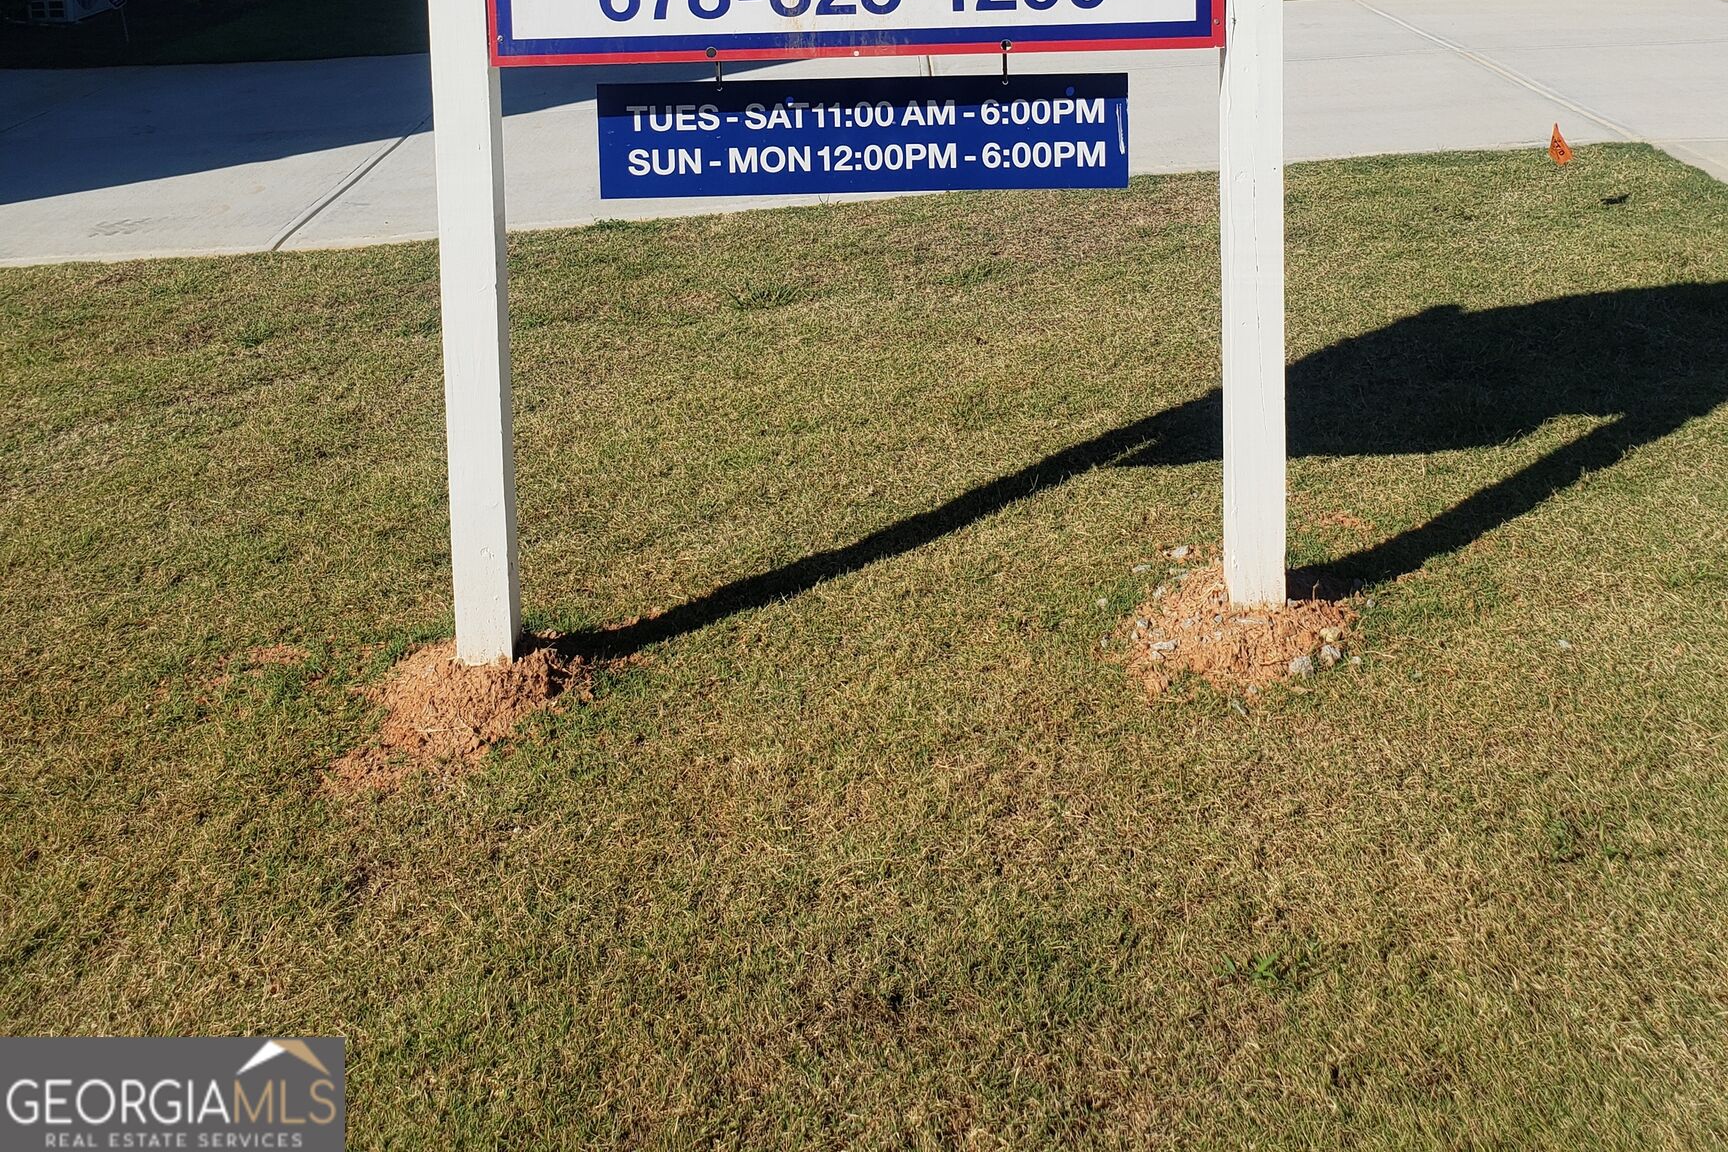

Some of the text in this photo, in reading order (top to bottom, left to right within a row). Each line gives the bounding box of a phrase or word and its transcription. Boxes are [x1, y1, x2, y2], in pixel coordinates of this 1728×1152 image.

[626, 104, 721, 133] TUES
[744, 101, 808, 130] SAT
[811, 101, 896, 129] 11:00
[901, 99, 956, 127] AM
[980, 97, 1106, 127] 6:00PM
[627, 147, 703, 176] SUN
[728, 145, 812, 174] MON
[817, 142, 957, 172] 12:00PM
[981, 140, 1106, 169] 6:00PM
